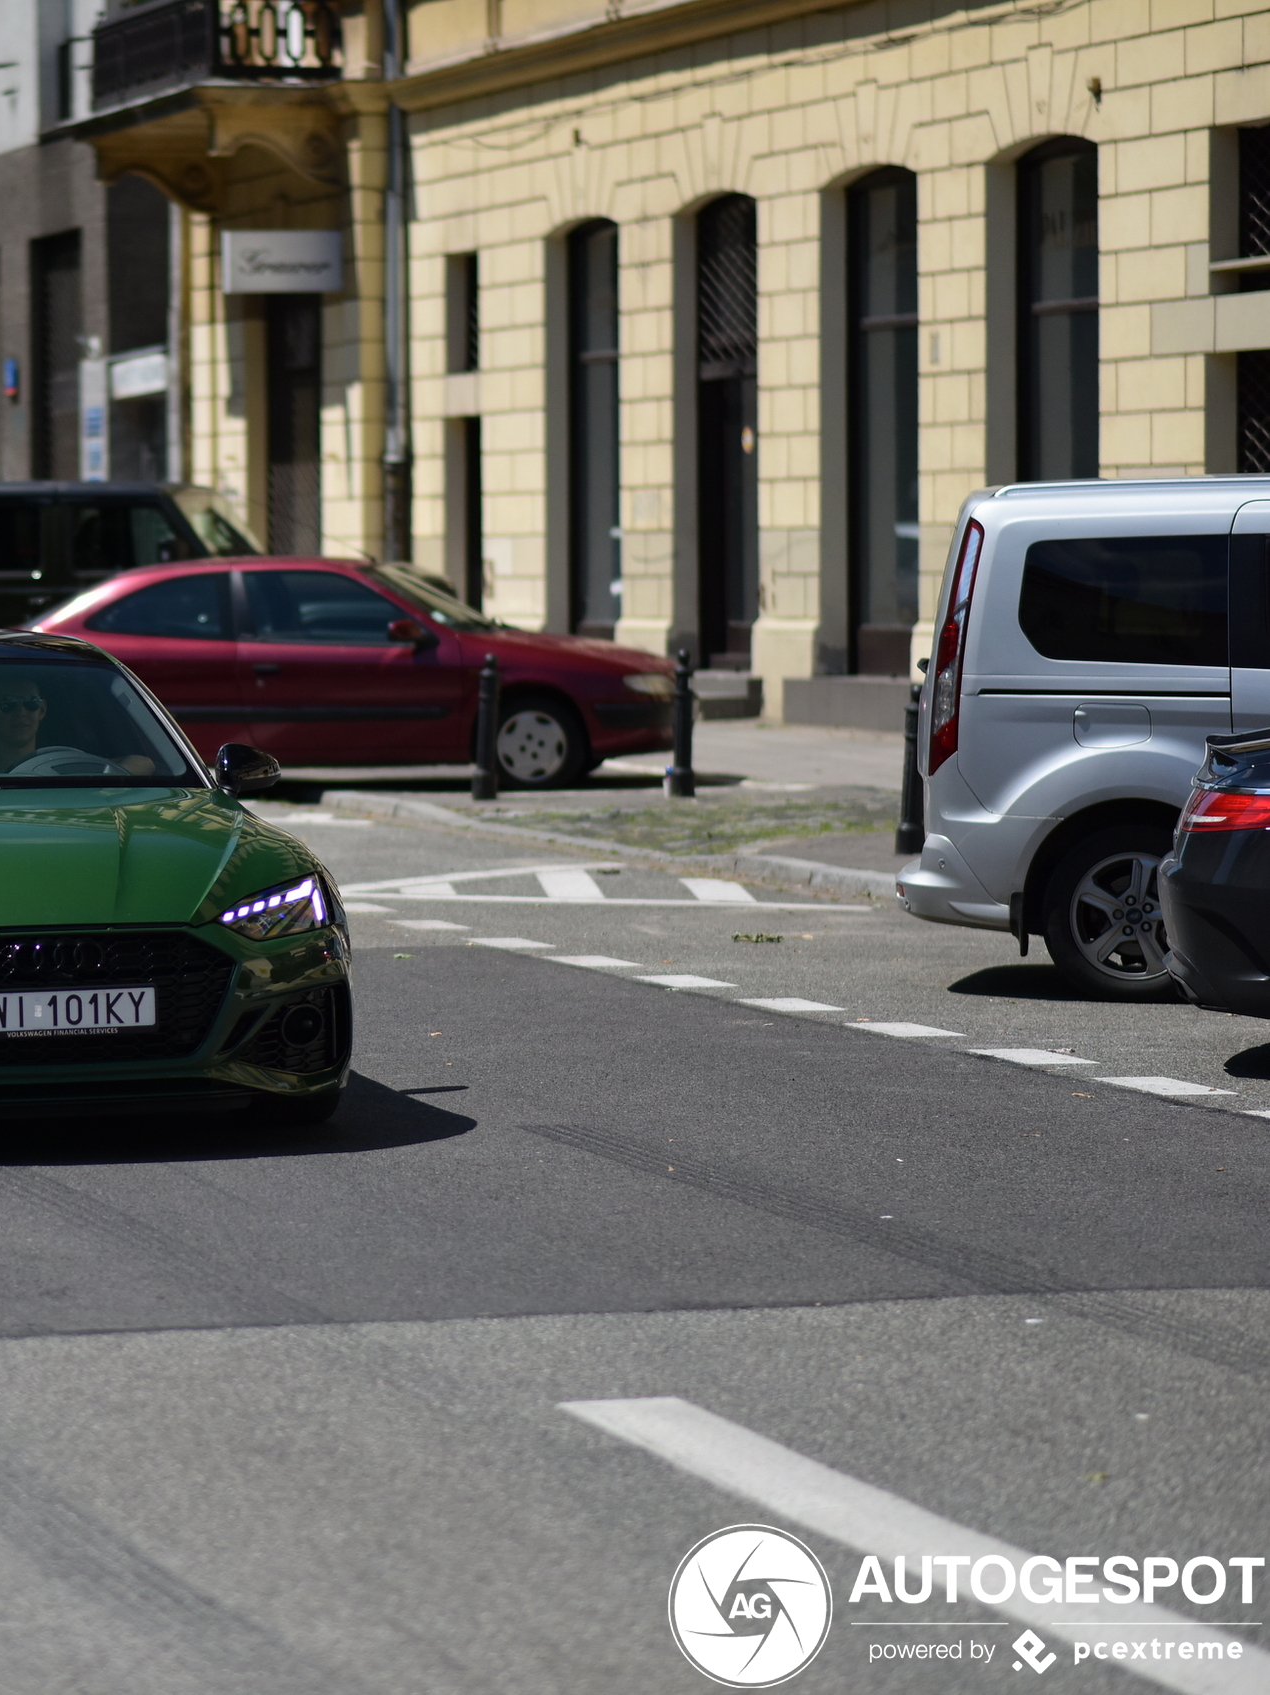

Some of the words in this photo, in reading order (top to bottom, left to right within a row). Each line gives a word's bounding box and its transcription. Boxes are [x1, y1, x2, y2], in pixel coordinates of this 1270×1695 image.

[47, 991, 146, 1026] 101KY
[7, 1030, 52, 1038] VOLKSWAGEN
[53, 1028, 88, 1036] FINANCIAL
[89, 1027, 119, 1035] SERVICES
